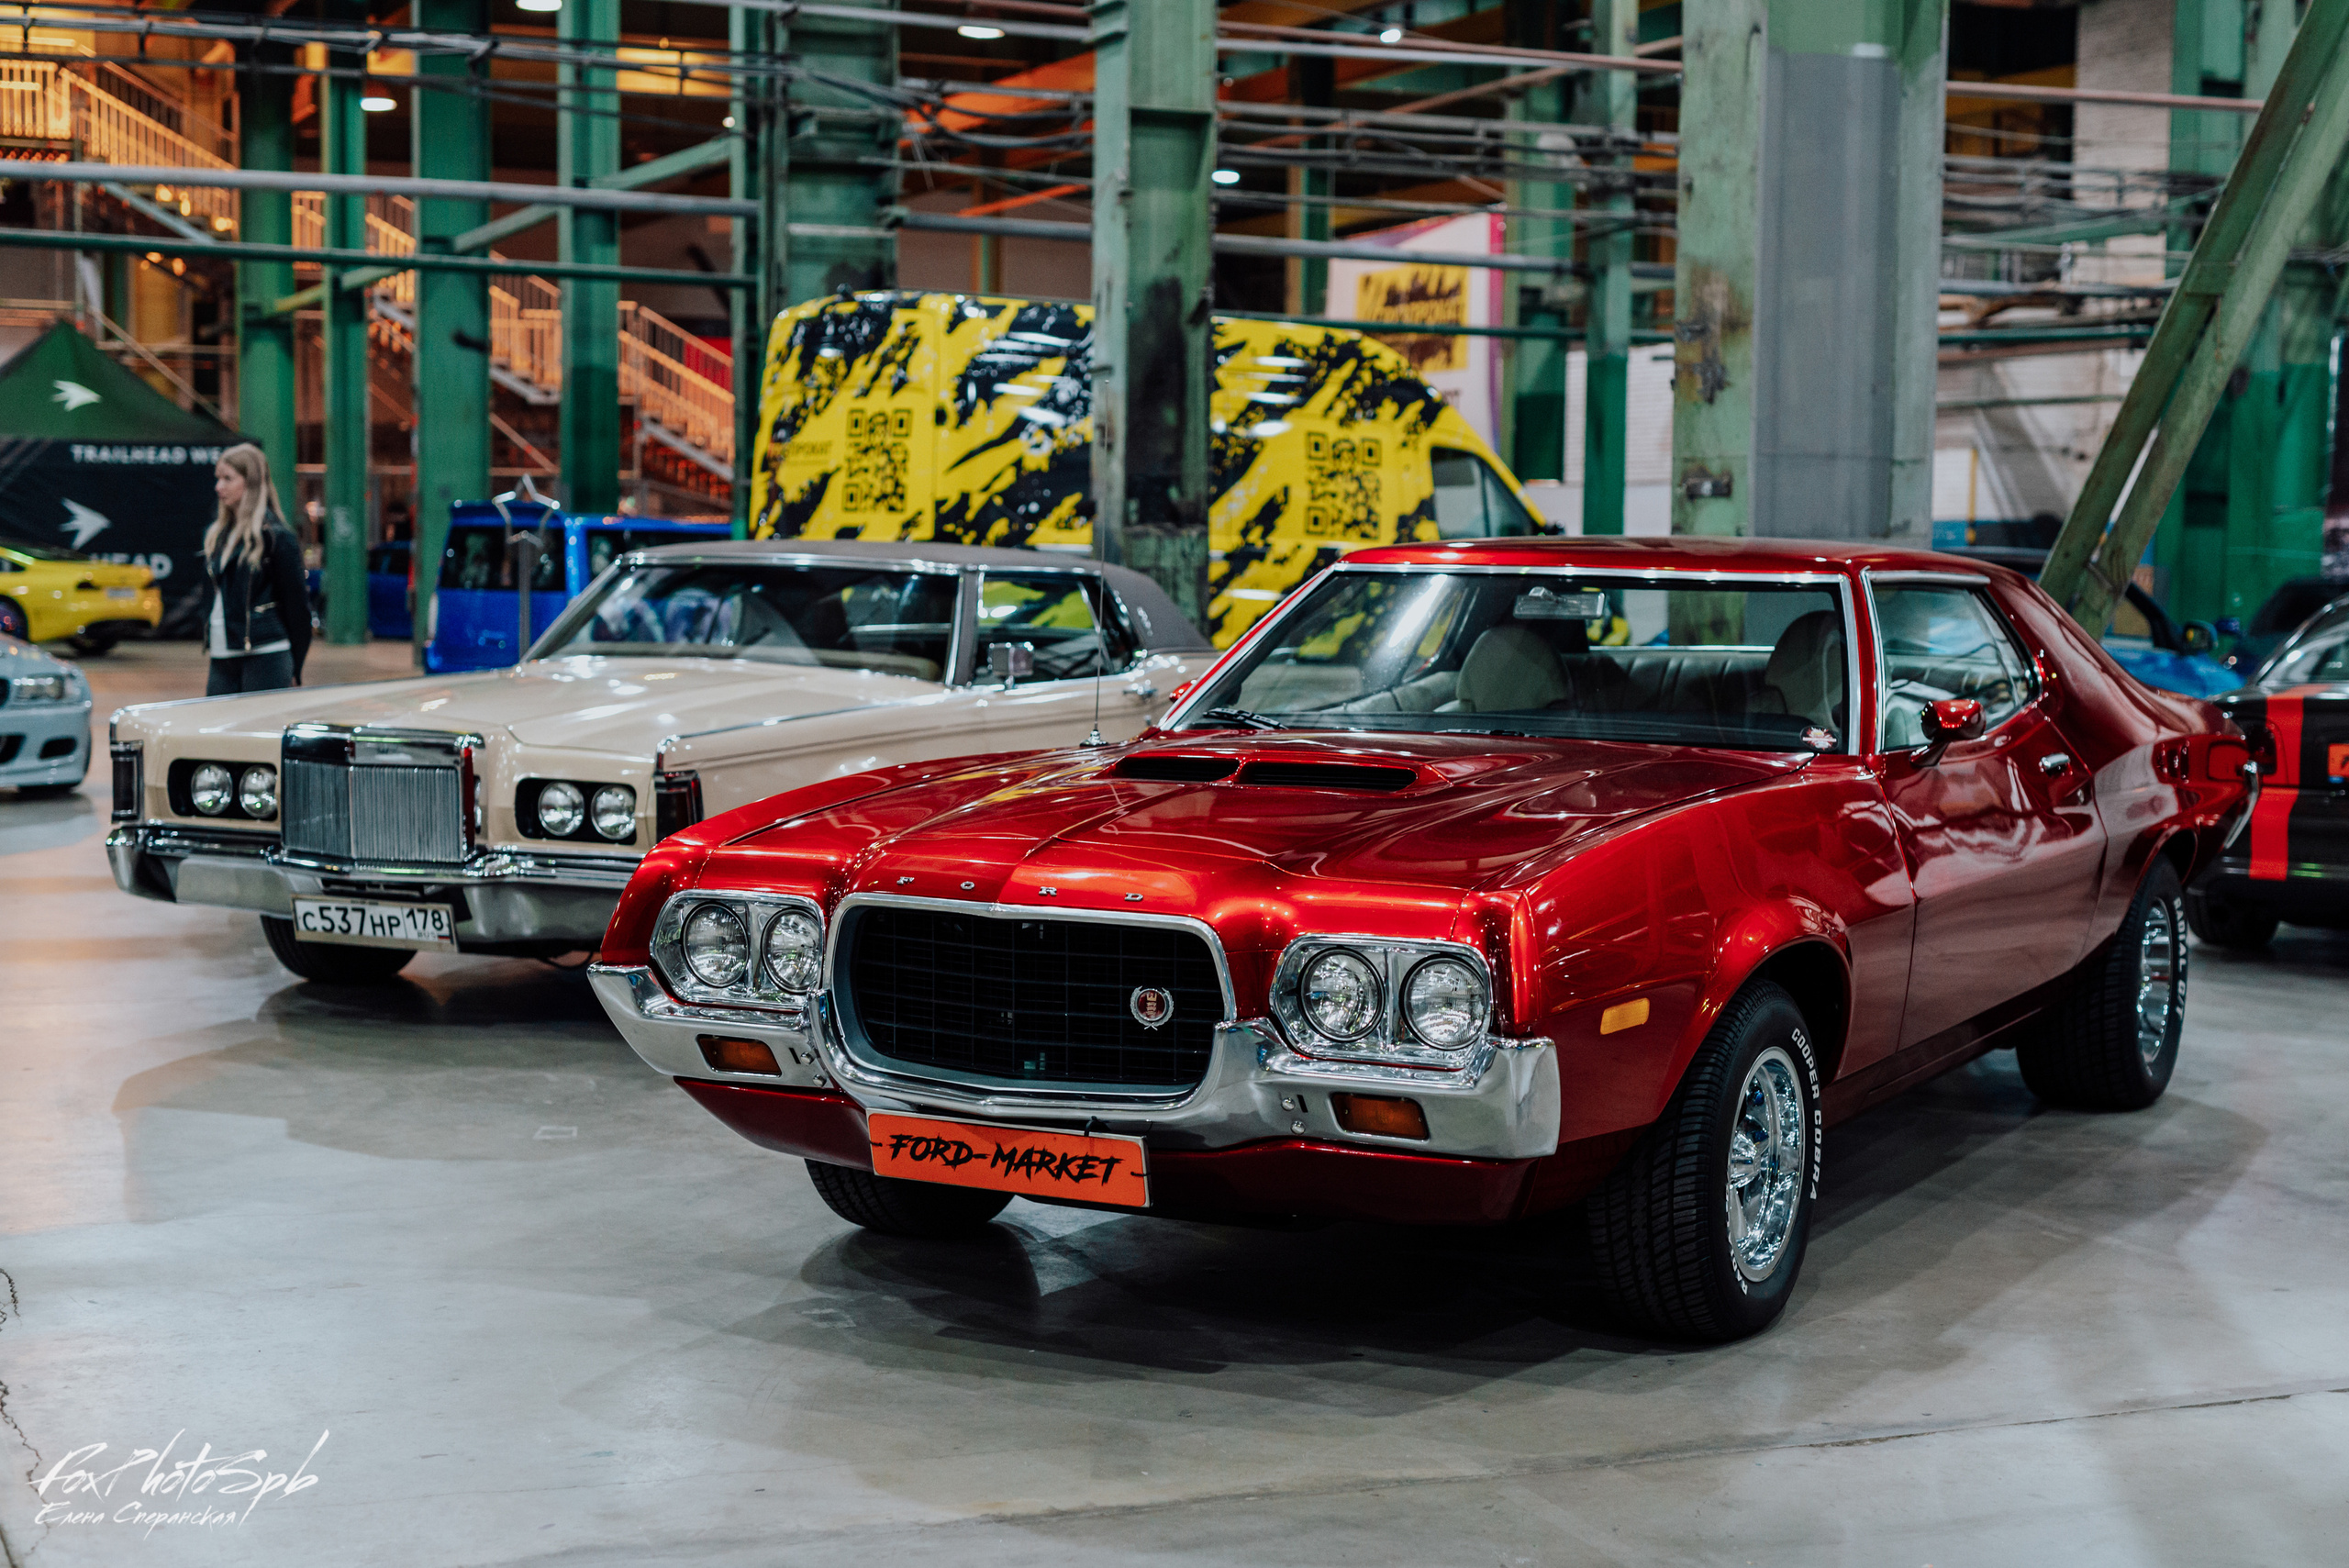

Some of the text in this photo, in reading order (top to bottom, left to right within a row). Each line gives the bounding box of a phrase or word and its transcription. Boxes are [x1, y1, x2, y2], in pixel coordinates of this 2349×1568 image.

[71, 444, 228, 465] TRAILHEAD WE
[896, 876, 1143, 902] FORD
[406, 908, 443, 930] 178
[2173, 896, 2187, 1020] RADIAL G/T
[1791, 1028, 1821, 1200] COOPER COBRA
[889, 1133, 1124, 1186] FORD-MARKET
